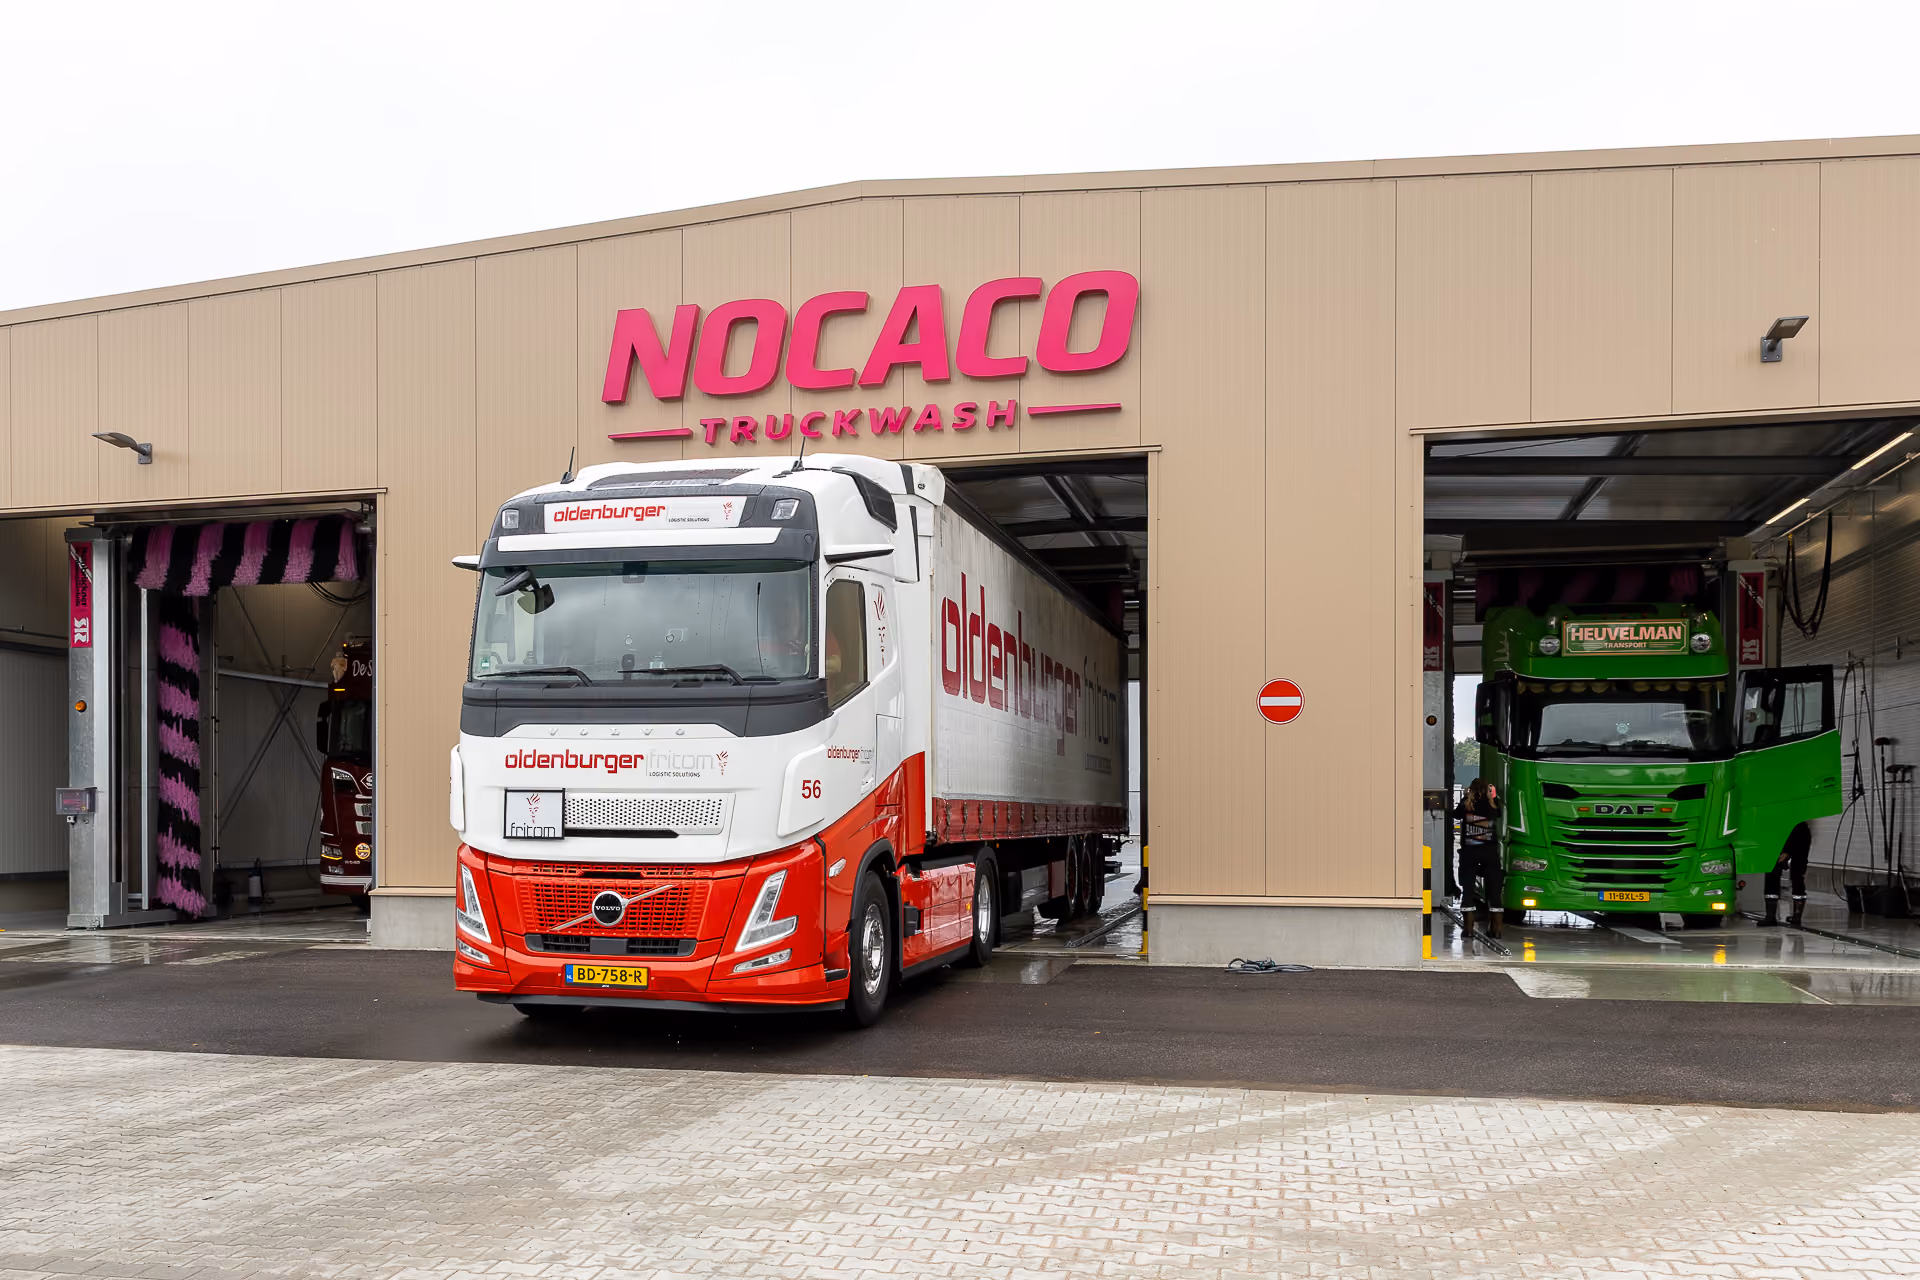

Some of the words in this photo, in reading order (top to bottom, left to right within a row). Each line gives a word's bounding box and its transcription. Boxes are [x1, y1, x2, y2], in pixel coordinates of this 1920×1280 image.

[601, 269, 1140, 405] NOCACO
[699, 399, 1017, 445] TRUCKWASH
[553, 504, 666, 523] oldenburger
[1570, 625, 1682, 641] HEUVELMAN
[1604, 641, 1647, 649] TRANSPORT
[941, 571, 1082, 757] oldenburger
[504, 748, 645, 774] oldenburger
[649, 748, 714, 770] fritom
[827, 744, 861, 763] oldenburger
[801, 779, 822, 799] 56
[1593, 803, 1655, 816] DAF
[510, 822, 556, 838] fritom
[1607, 892, 1645, 901] 11-BXL-5
[577, 967, 642, 984] BD-758-R
